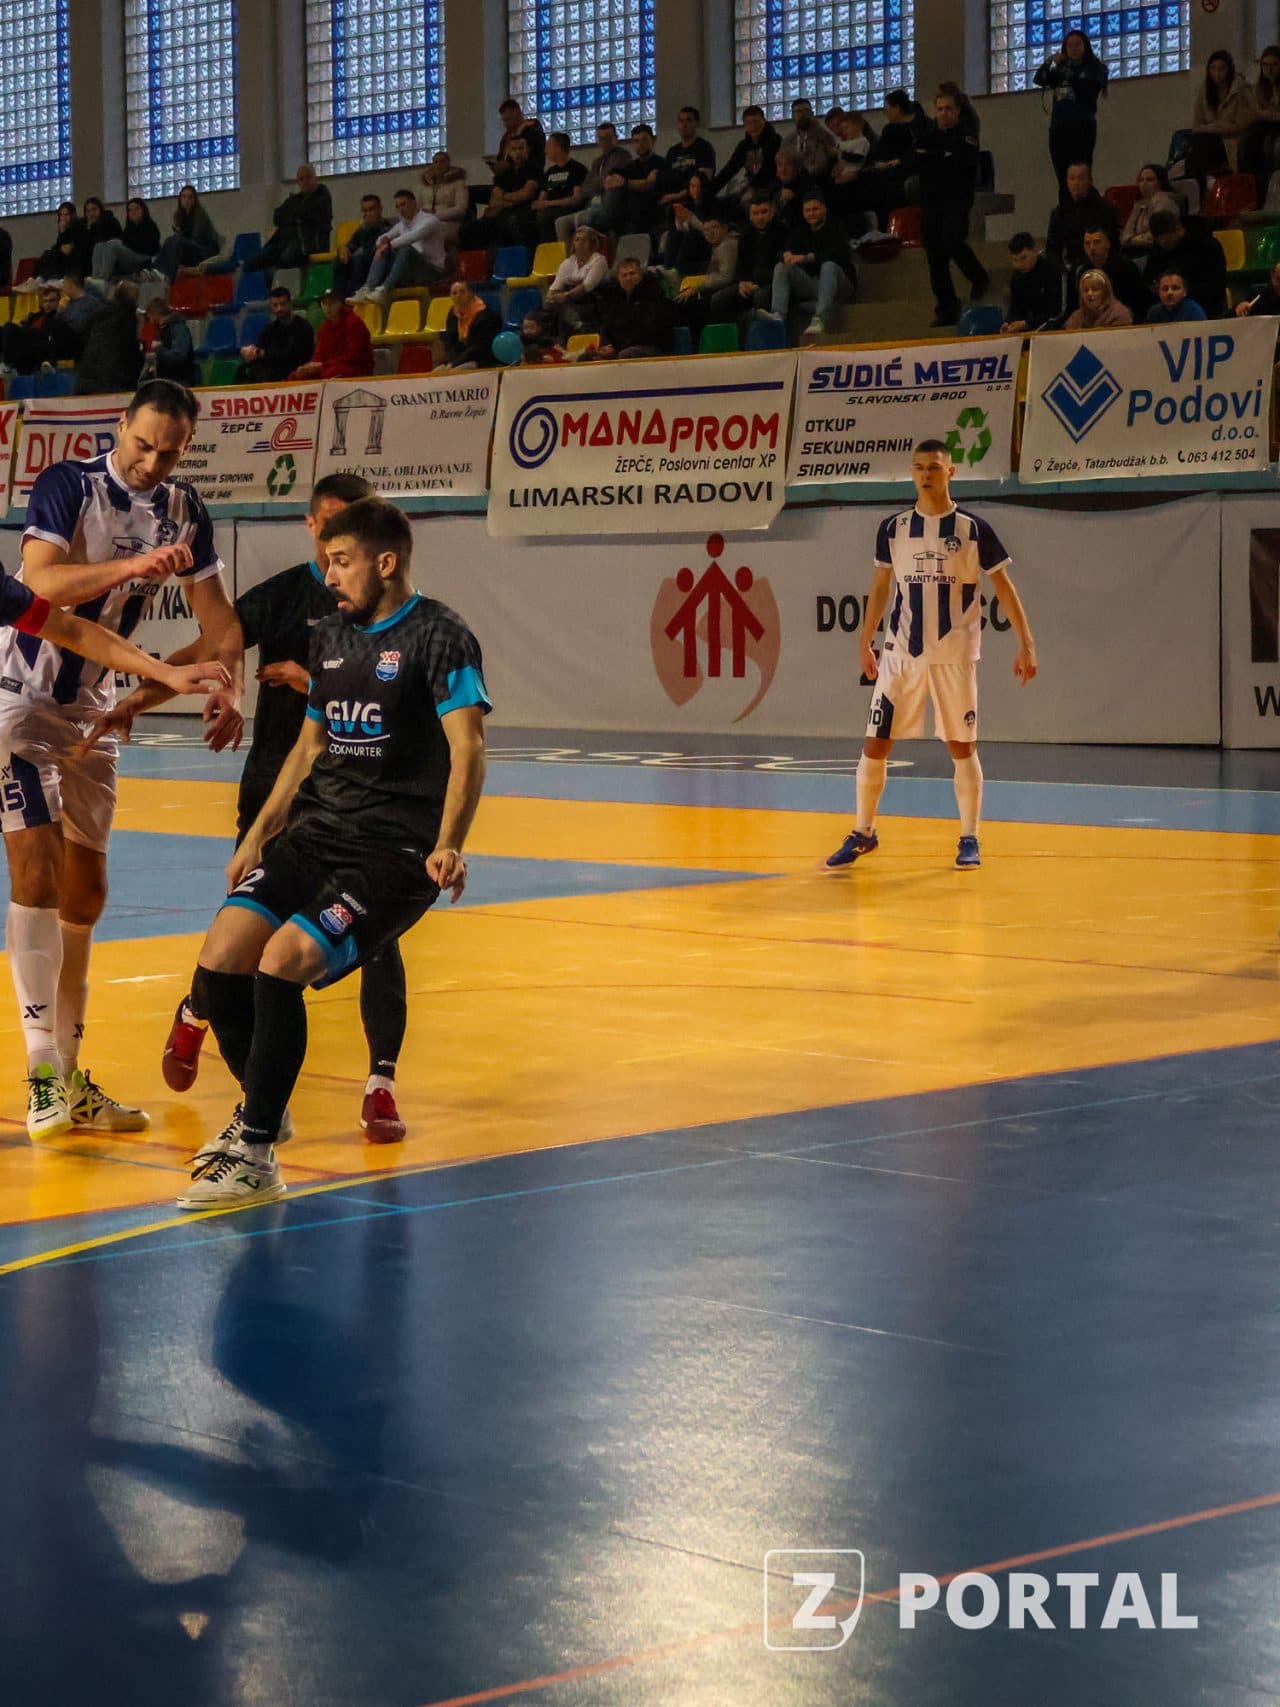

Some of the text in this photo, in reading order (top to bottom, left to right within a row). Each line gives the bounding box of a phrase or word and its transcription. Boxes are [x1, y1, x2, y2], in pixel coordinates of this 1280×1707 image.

[1158, 334, 1235, 384] VIP
[808, 354, 1012, 389] SUDIĆ METAL
[210, 392, 318, 417] SIROVINE
[391, 387, 489, 407] GRANIT MARIO
[846, 390, 968, 405] SLAVONSKI BROD
[1127, 379, 1263, 427] Podovi
[221, 422, 263, 433] ŽEPČE
[561, 409, 780, 453] MANAPROM
[805, 418, 856, 433] OTKUP
[1211, 424, 1259, 442] d.o.o.
[801, 438, 913, 455] SEKUNDARNIH
[1188, 452, 1208, 464] 063
[1211, 449, 1231, 462] 412
[1235, 447, 1255, 460] 504
[394, 463, 472, 477] OBLIKOVANJE
[615, 453, 777, 473] ŽEPČE, Poslovni centar XP
[797, 462, 870, 477] SIROVINA
[371, 479, 454, 491] RADA KAMENA
[509, 481, 773, 508] LIMARSKI RADOVI
[325, 700, 383, 735] GVG
[233, 868, 265, 892] 2
